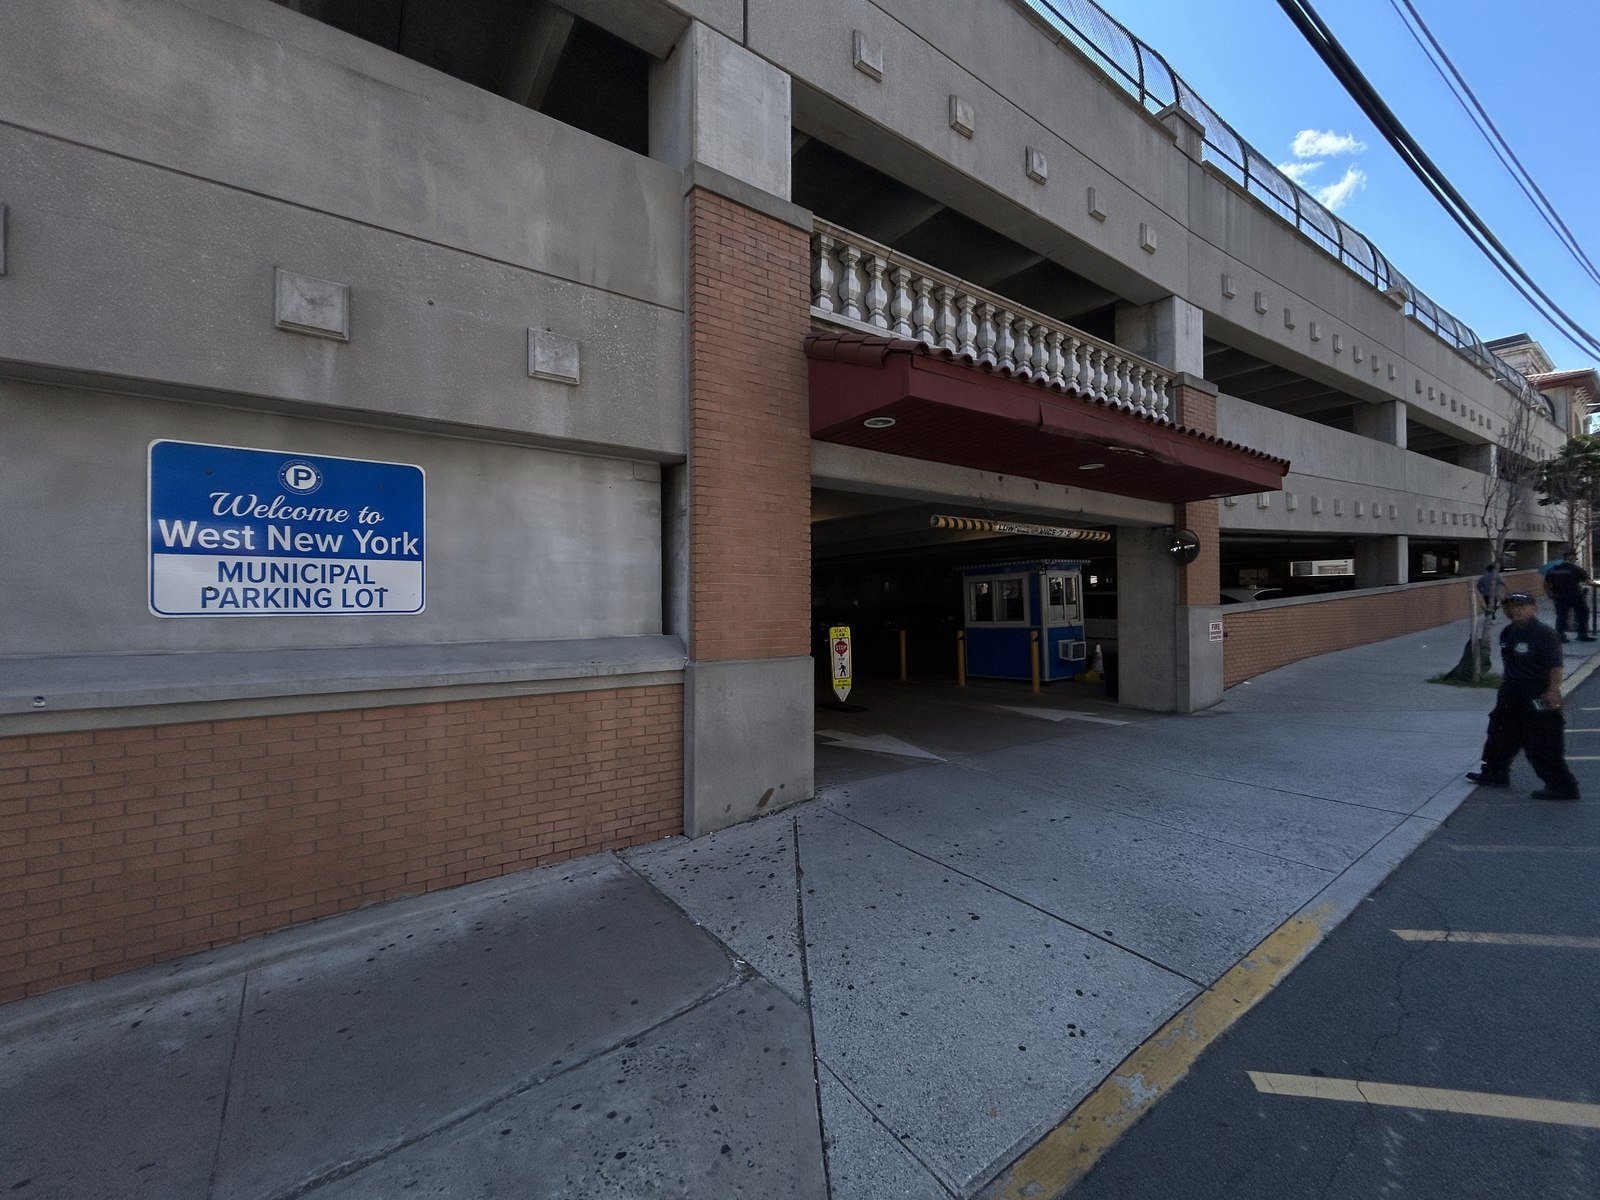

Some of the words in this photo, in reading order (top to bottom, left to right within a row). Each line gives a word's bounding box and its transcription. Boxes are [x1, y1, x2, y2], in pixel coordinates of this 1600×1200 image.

[294, 468, 312, 486] P
[209, 492, 350, 523] Welcome
[358, 506, 384, 525] to
[158, 519, 255, 550] West
[267, 524, 343, 552] New
[352, 529, 419, 555] York
[998, 524, 1014, 532] LOW
[1016, 526, 1056, 536] CANCE
[218, 561, 375, 585] MUNICIPAL
[201, 587, 332, 609] PARKING
[342, 588, 388, 608] LOT
